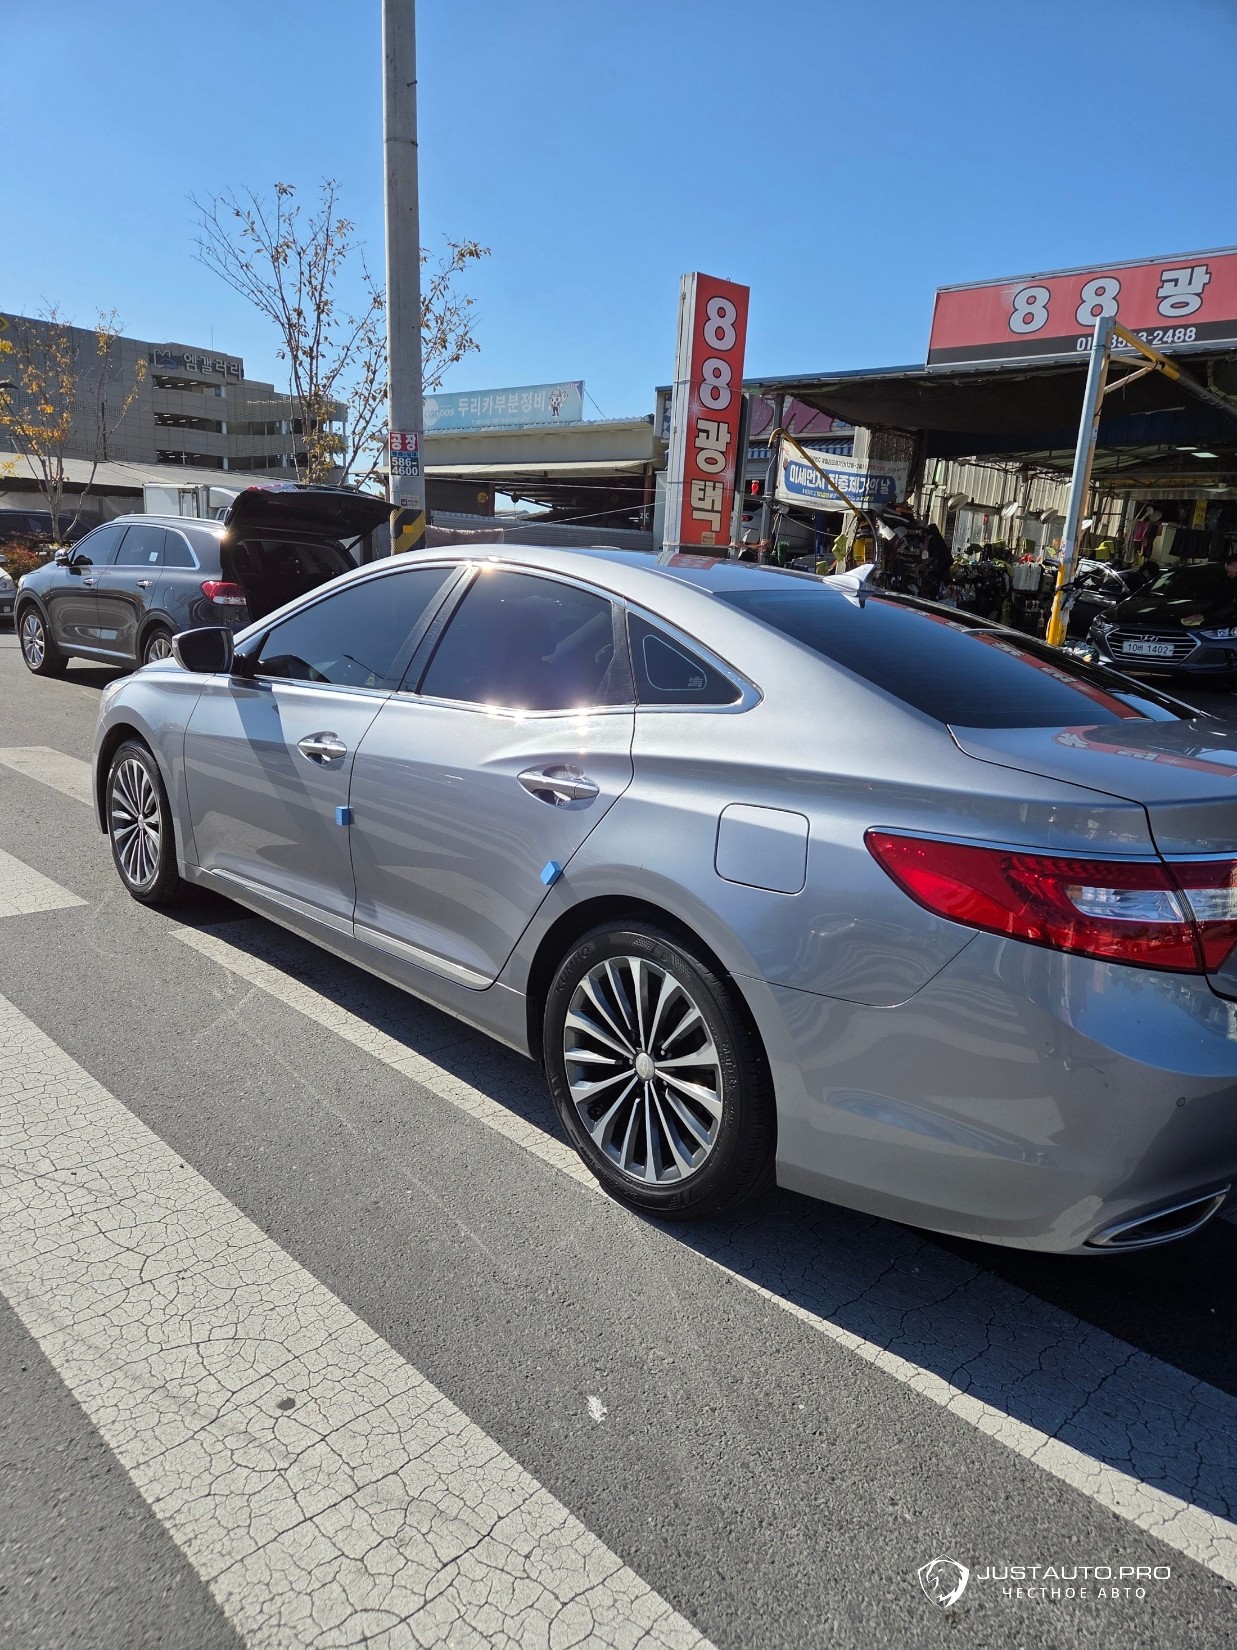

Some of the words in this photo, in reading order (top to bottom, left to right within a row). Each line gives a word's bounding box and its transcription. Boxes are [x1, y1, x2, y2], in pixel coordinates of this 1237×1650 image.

[183, 353, 241, 380] 엠갤러리
[391, 434, 416, 451] 공장
[391, 457, 417, 467] 586-
[391, 466, 418, 475] 4600
[789, 464, 825, 490] 미세먼지
[880, 478, 891, 495] 날
[1147, 644, 1169, 655] 1402
